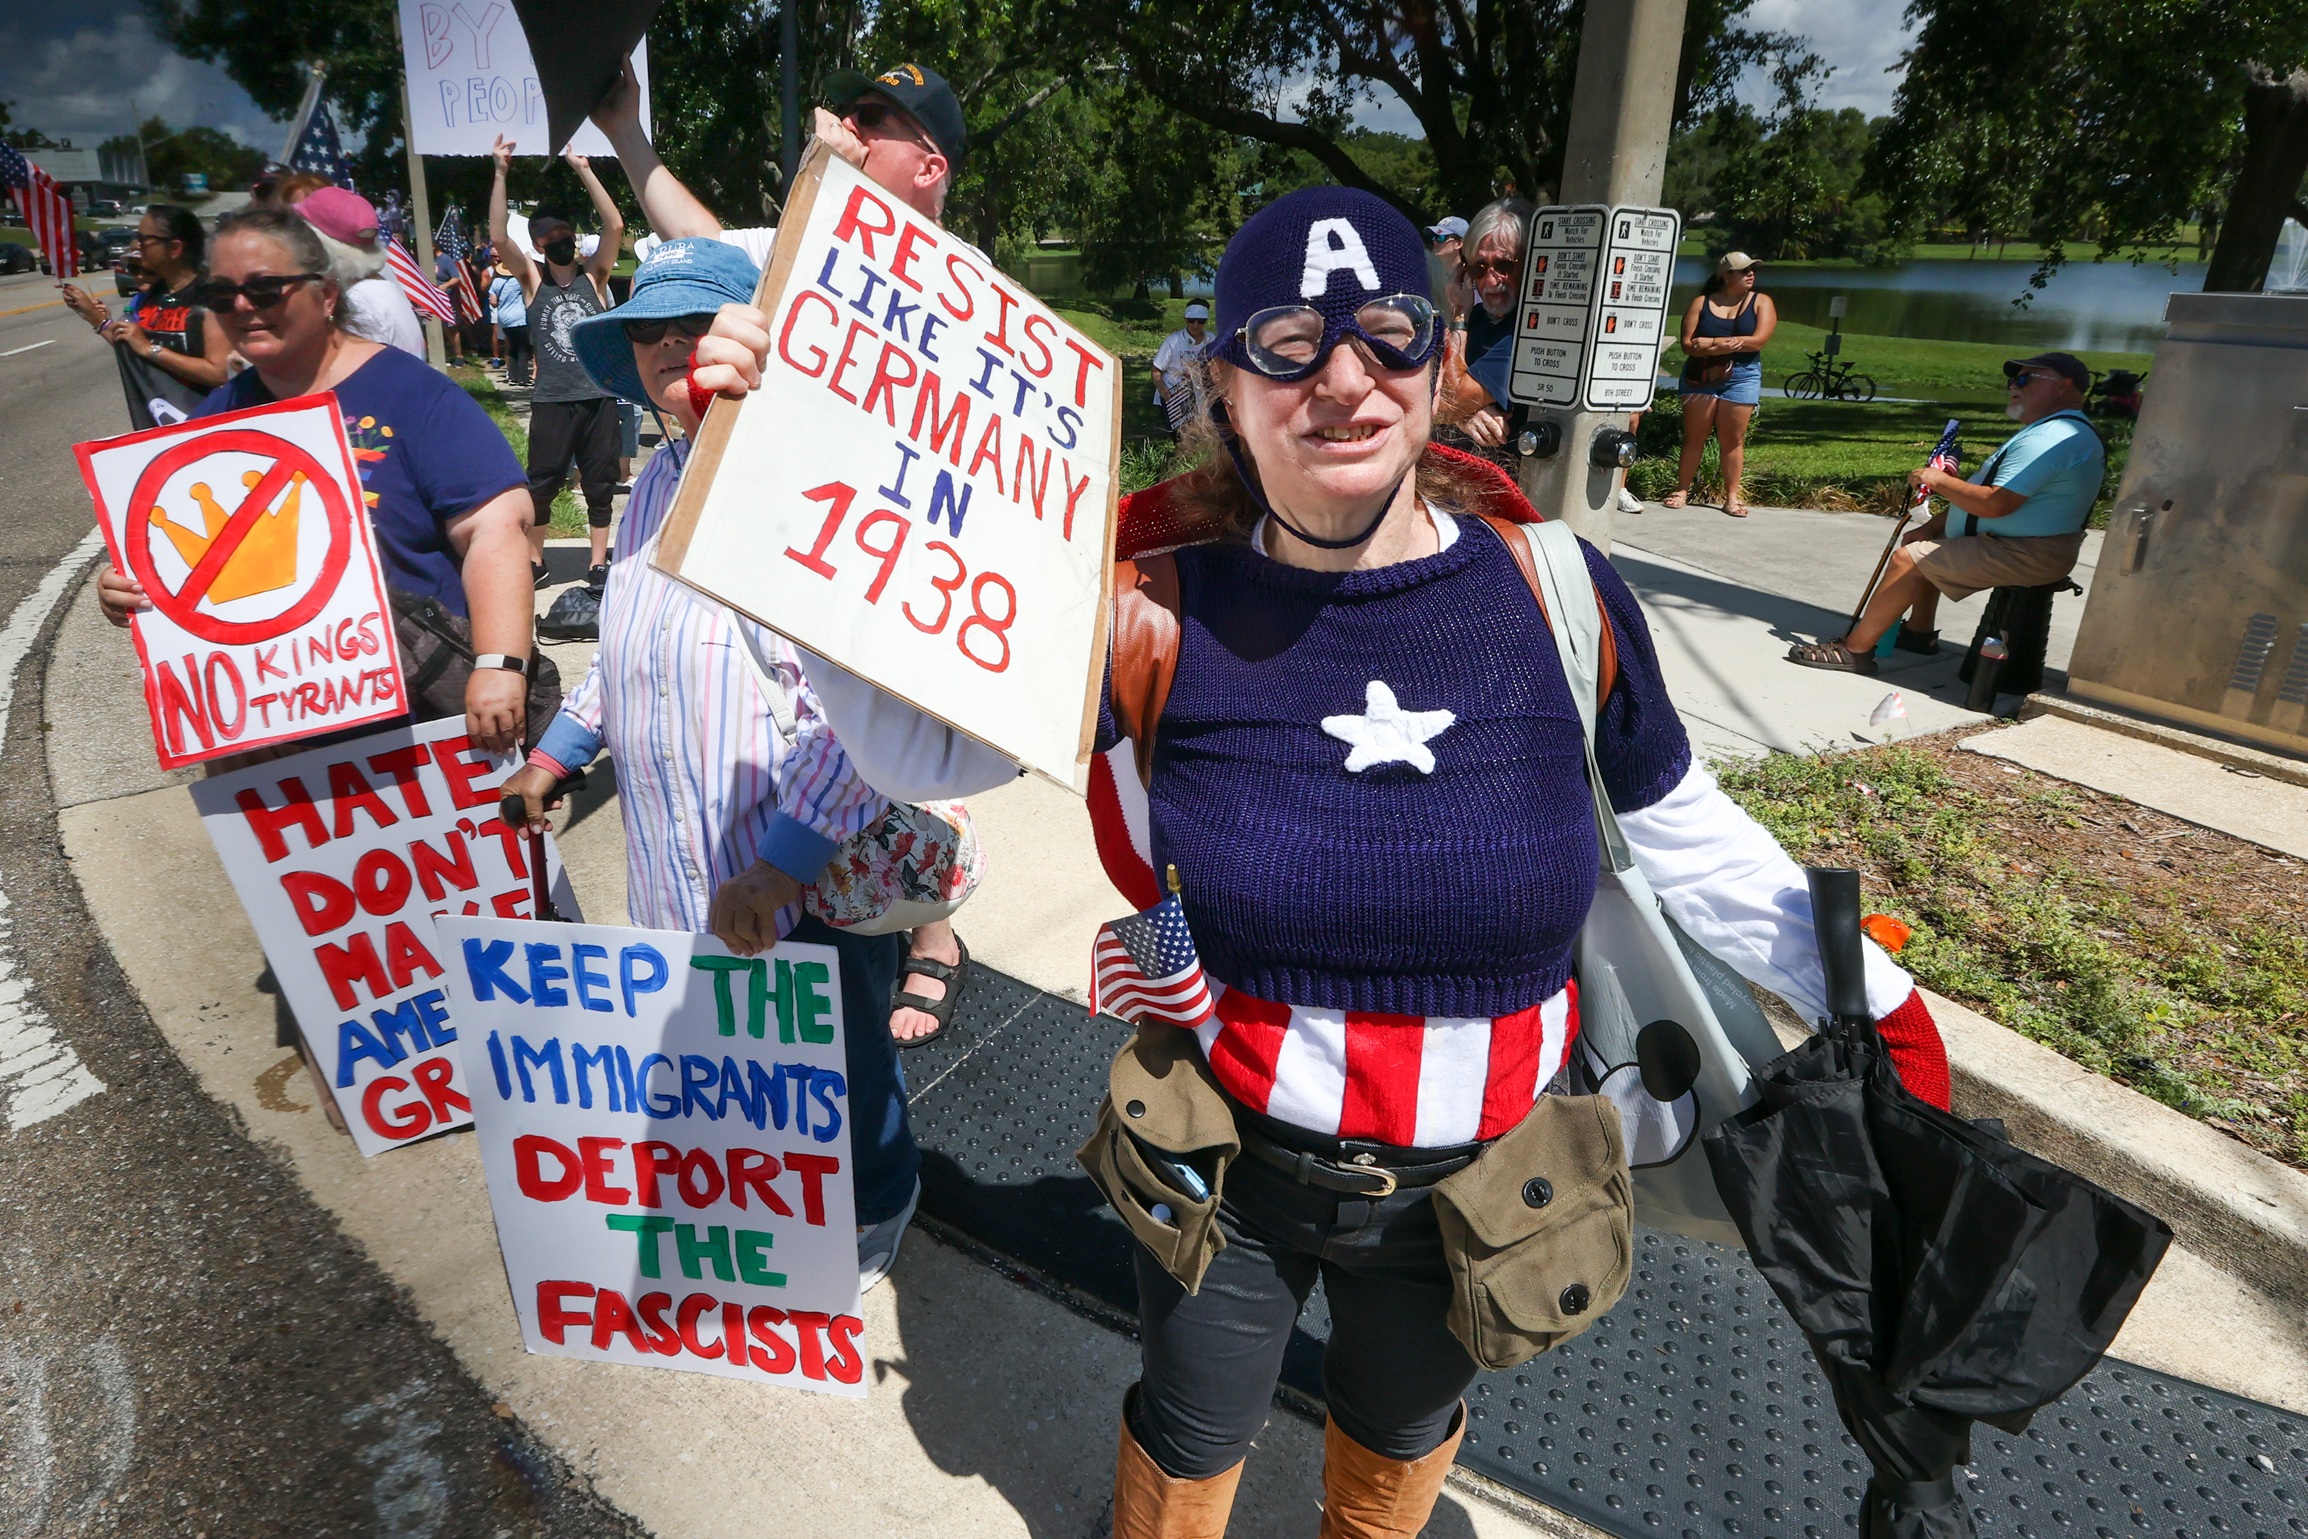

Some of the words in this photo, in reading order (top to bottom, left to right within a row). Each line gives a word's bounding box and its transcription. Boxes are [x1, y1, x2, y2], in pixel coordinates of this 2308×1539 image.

[421, 2, 505, 70] BY
[1558, 217, 1572, 225] START
[1573, 216, 1596, 225] CROSSING
[1634, 217, 1647, 227] START
[1648, 219, 1669, 228] CROSSING
[1565, 227, 1579, 235] Watch
[1581, 227, 1589, 235] For
[1566, 236, 1585, 244] Vehicles
[1641, 238, 1659, 247] Vehicles
[650, 242, 695, 258] ARUBA
[1557, 252, 1571, 260] DON'T
[1572, 252, 1586, 260] START
[1300, 217, 1381, 299] A
[1647, 255, 1660, 263] START
[1554, 262, 1567, 270] Finish
[1568, 262, 1587, 271] Crossing
[1630, 264, 1643, 272] Finish
[1644, 265, 1661, 275] Crossing
[1563, 271, 1579, 279] Started
[1639, 274, 1654, 282] Started
[1550, 282, 1560, 290] TIME
[1562, 282, 1588, 291] REMAINING
[1638, 285, 1661, 294] REMAINING
[833, 185, 1104, 409] RESIST
[1555, 291, 1567, 299] Finish
[1568, 291, 1587, 301] Crossing
[1632, 294, 1643, 302] Finish
[1644, 295, 1660, 305] Crossing
[1547, 316, 1561, 325] DON'T
[1563, 317, 1578, 327] CROSS
[1624, 320, 1637, 328] DON'T
[1639, 321, 1653, 330] CROSS
[817, 247, 949, 363] LIKE
[970, 346, 1084, 450] IT'S
[1531, 346, 1545, 355] PUSH
[1546, 348, 1567, 358] BUTTON
[1608, 352, 1621, 360] PUSH
[1623, 352, 1642, 360] BUTTON
[1534, 358, 1541, 366] TO
[1542, 359, 1560, 368] CROSS
[1612, 363, 1618, 371] TO
[1619, 363, 1636, 372] CROSS
[1537, 383, 1544, 391] SR
[1546, 384, 1554, 392] 50
[1604, 389, 1614, 397] 8TH
[1615, 389, 1633, 397] STREET
[778, 290, 1091, 542] GERMANY
[878, 441, 974, 539] IN
[784, 480, 1018, 673] 1938
[156, 650, 248, 755] NO
[255, 611, 381, 685] KINGS
[250, 666, 396, 728] TYRANTS
[234, 735, 503, 864] HATE
[280, 818, 530, 936] DON'T
[1694, 950, 1725, 979] plastic
[1693, 965, 1713, 986] from
[462, 938, 669, 1018] KEEP
[690, 955, 835, 1045] THE
[1712, 985, 1737, 1010] Made
[1721, 978, 1760, 1014] recycled
[336, 984, 457, 1088] AME
[486, 1029, 846, 1143] IMMIGRANTS
[513, 1134, 840, 1227] DEPORT
[606, 1213, 787, 1287] THE
[536, 1279, 864, 1384] FASCISTS
